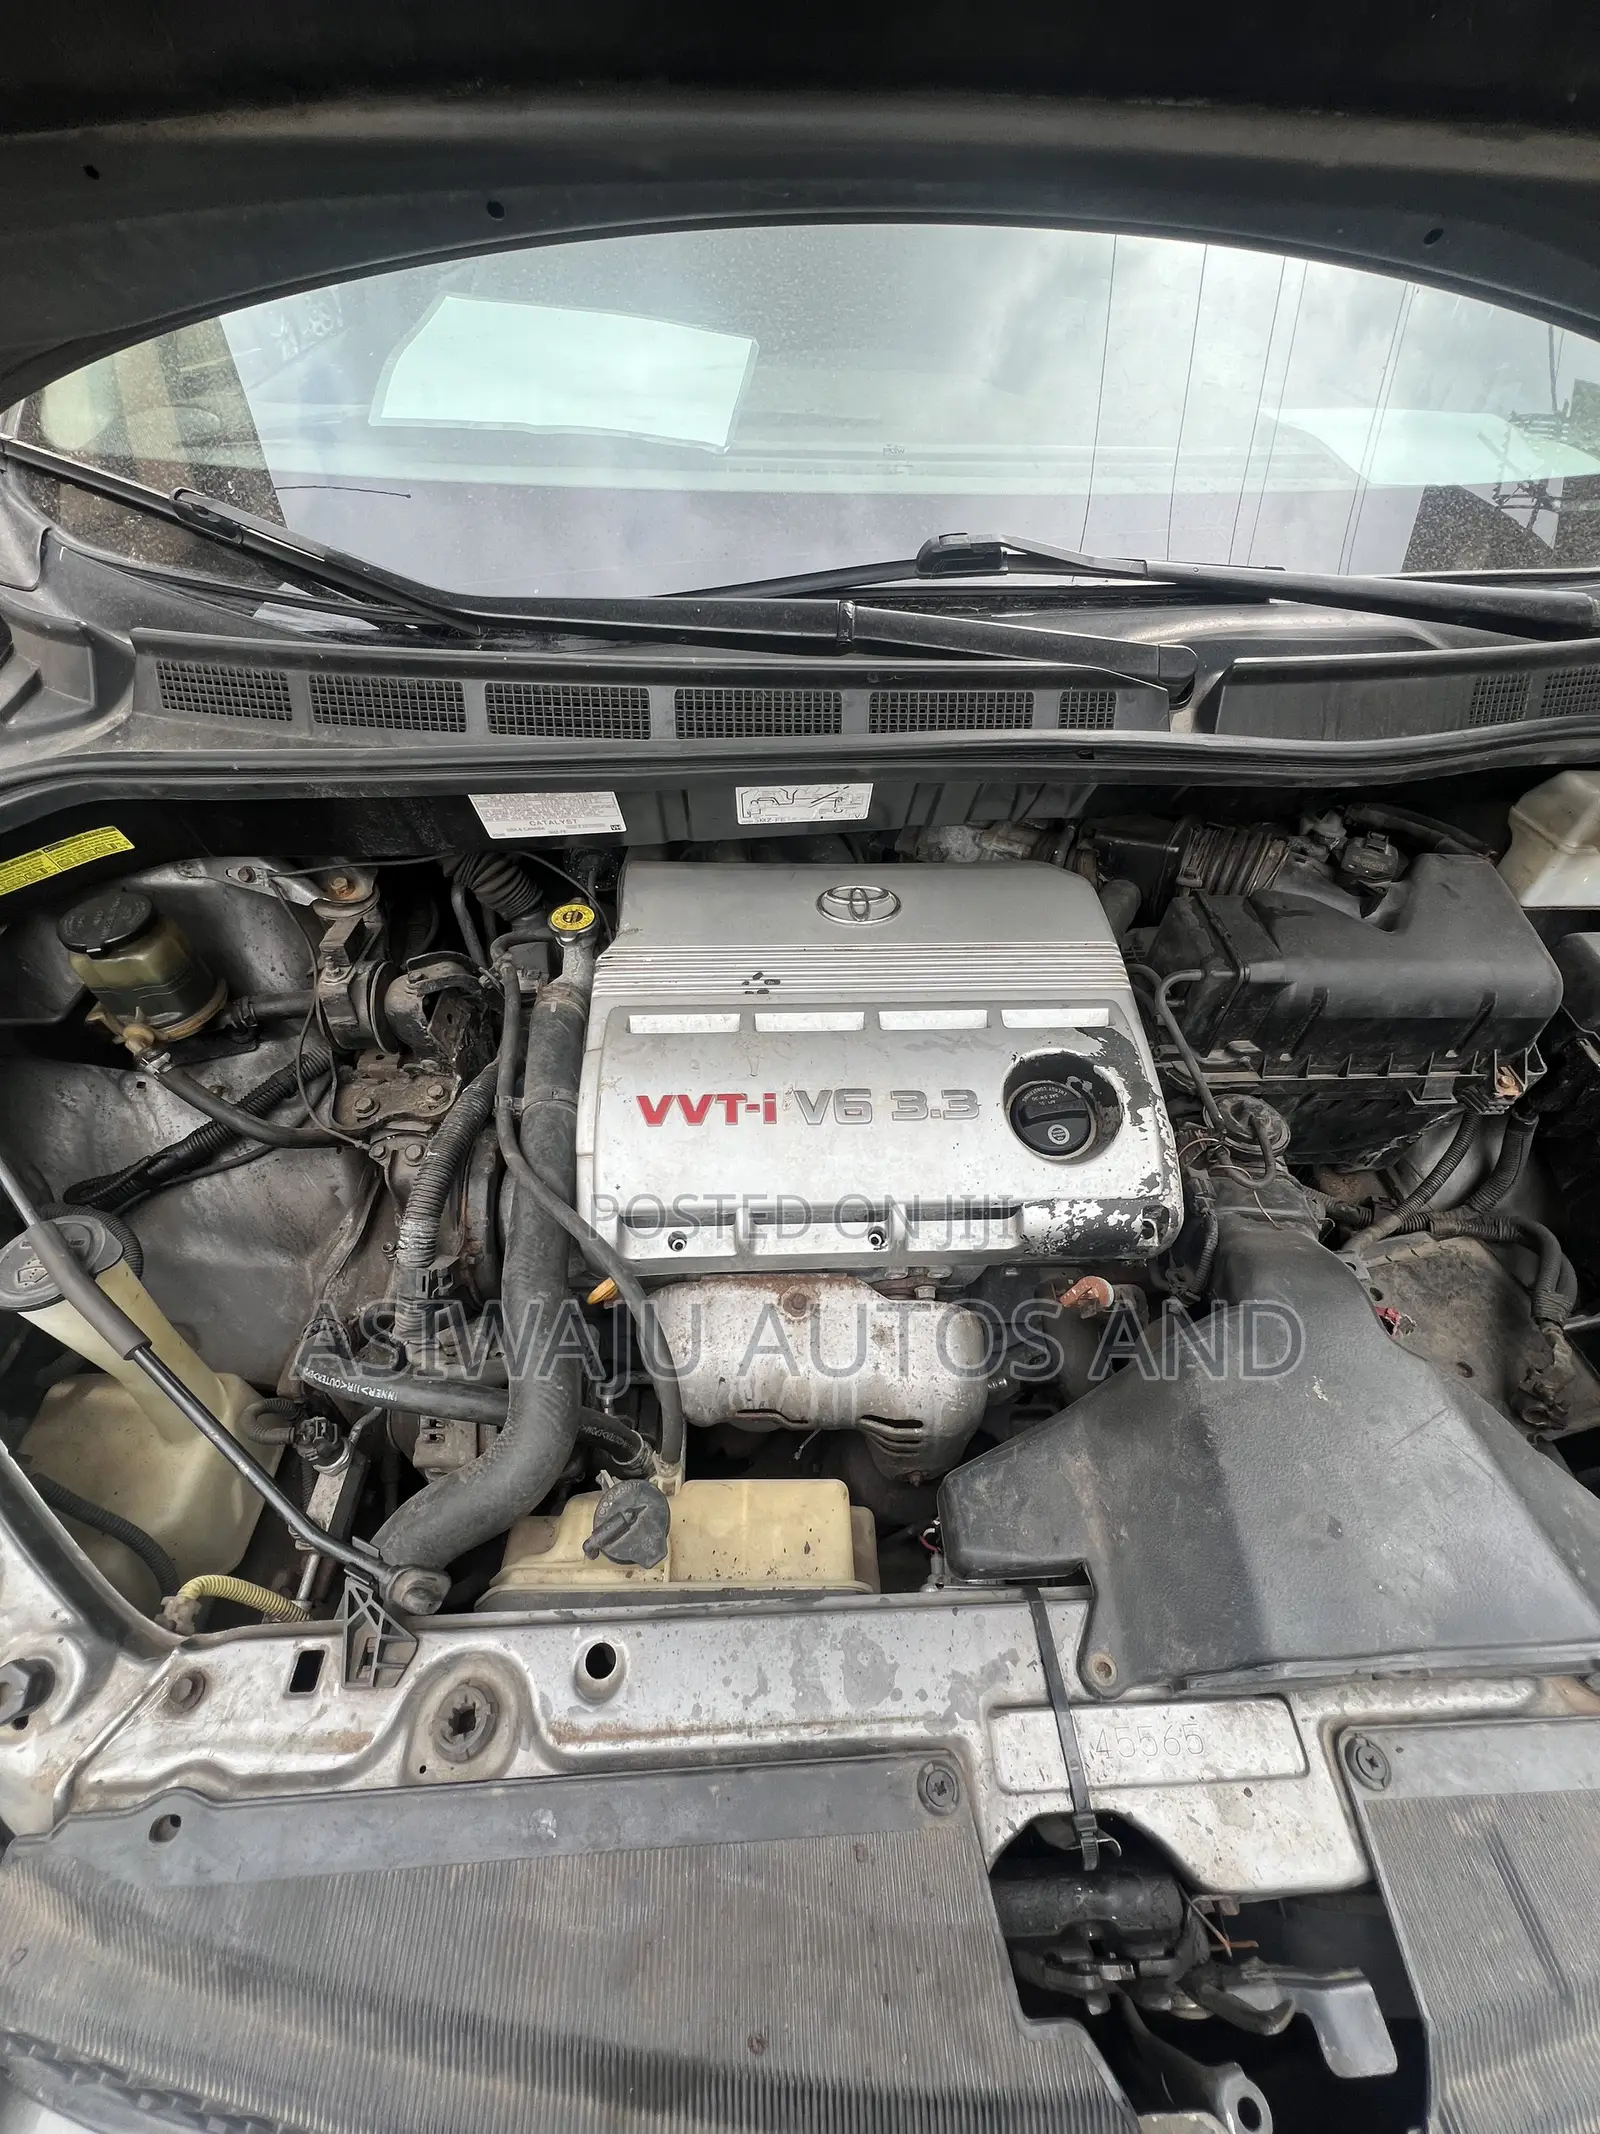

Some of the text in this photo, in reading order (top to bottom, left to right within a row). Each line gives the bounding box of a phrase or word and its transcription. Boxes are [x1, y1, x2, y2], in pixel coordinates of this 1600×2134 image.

[528, 819, 578, 827] CATALYST
[636, 1088, 980, 1127] VVT-i V6 3.3
[1095, 1723, 1206, 1759] 45565
